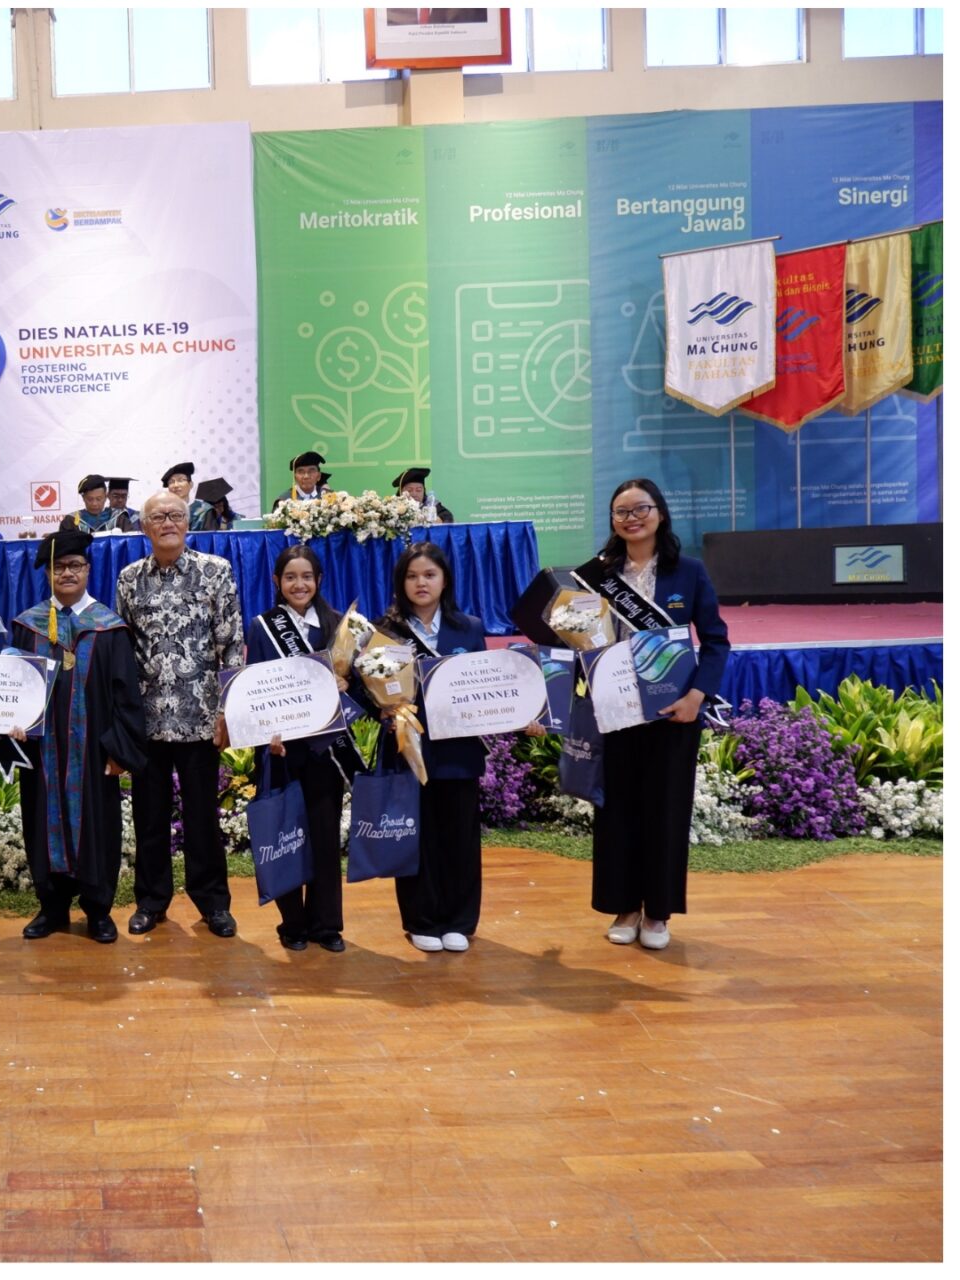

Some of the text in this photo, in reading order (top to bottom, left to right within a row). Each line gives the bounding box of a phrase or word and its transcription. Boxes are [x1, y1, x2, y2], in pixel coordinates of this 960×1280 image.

[838, 184, 908, 208] Sinergi
[469, 200, 582, 222] Profesional
[616, 195, 745, 218] Bertanggung
[300, 208, 419, 230] Meritokratik
[681, 212, 746, 233] Jawab
[18, 322, 189, 341] DIES NATALIS KE-19
[696, 332, 748, 342] UNIVERSITAS
[19, 338, 236, 360] UNIVERSITAS MA CHUNG
[687, 340, 758, 356] MA CHUNG
[847, 338, 886, 352] HUNG
[21, 362, 87, 374] FOSTERING
[21, 372, 129, 384] TRANSFORMATIVE
[22, 383, 111, 395] CONVERGENCE
[249, 694, 312, 712] 3rd WINNER
[451, 688, 519, 704] 2nd WINNER
